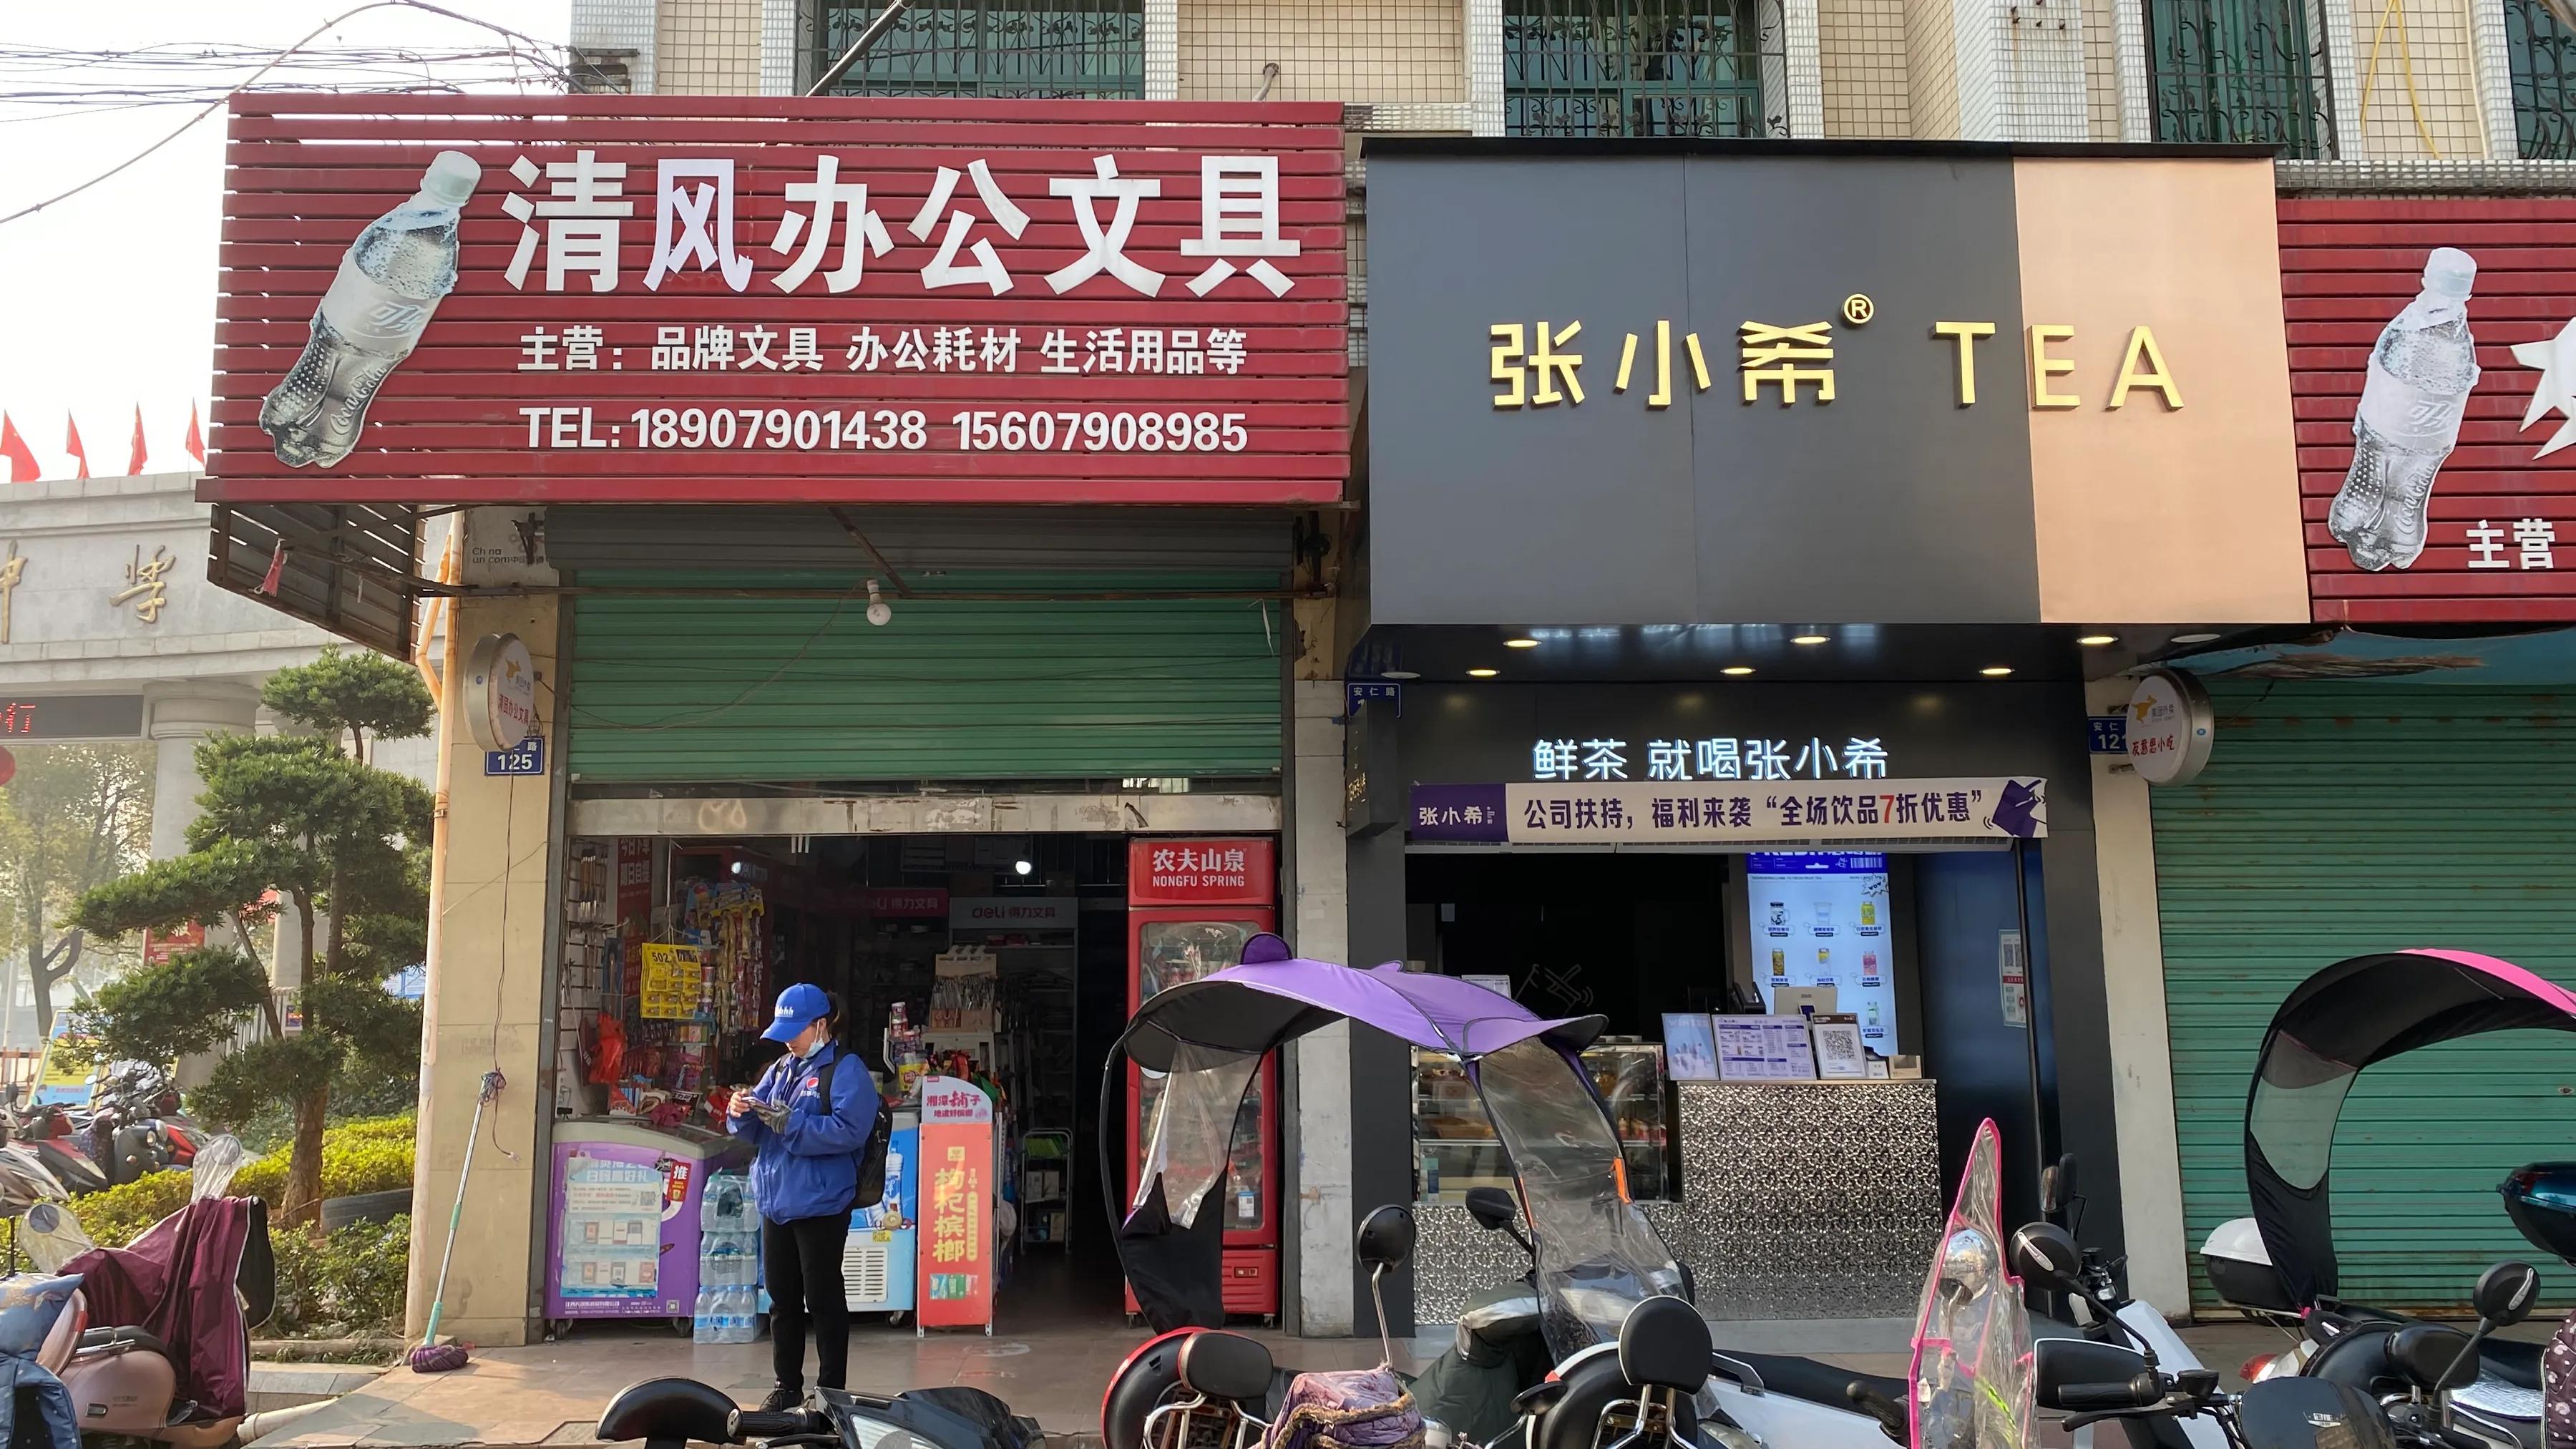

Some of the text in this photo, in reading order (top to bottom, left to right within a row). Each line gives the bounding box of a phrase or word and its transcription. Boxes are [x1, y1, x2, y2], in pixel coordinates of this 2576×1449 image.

[500, 149, 1302, 298] 清风办公文具
[846, 326, 1019, 374] 办公耗材
[1040, 328, 1248, 375] 生活用品等
[1490, 320, 1835, 409] 张小希
[1933, 320, 2185, 411] TEA
[952, 410, 1249, 452] 15607908985
[2466, 518, 2555, 569] 主营
[1353, 687, 1395, 696] 安仁路
[497, 753, 533, 771] 125
[1533, 736, 1888, 781] 鲜茶 就喝张小希
[1419, 805, 1483, 826] 张小希
[1152, 848, 1245, 873] 农夫山泉
[1152, 875, 1245, 887] NONGFU SPRING
[652, 952, 668, 963] 502
[927, 1091, 981, 1108] 湘潭铺子
[932, 1167, 965, 1263] 枸杞槟榔
